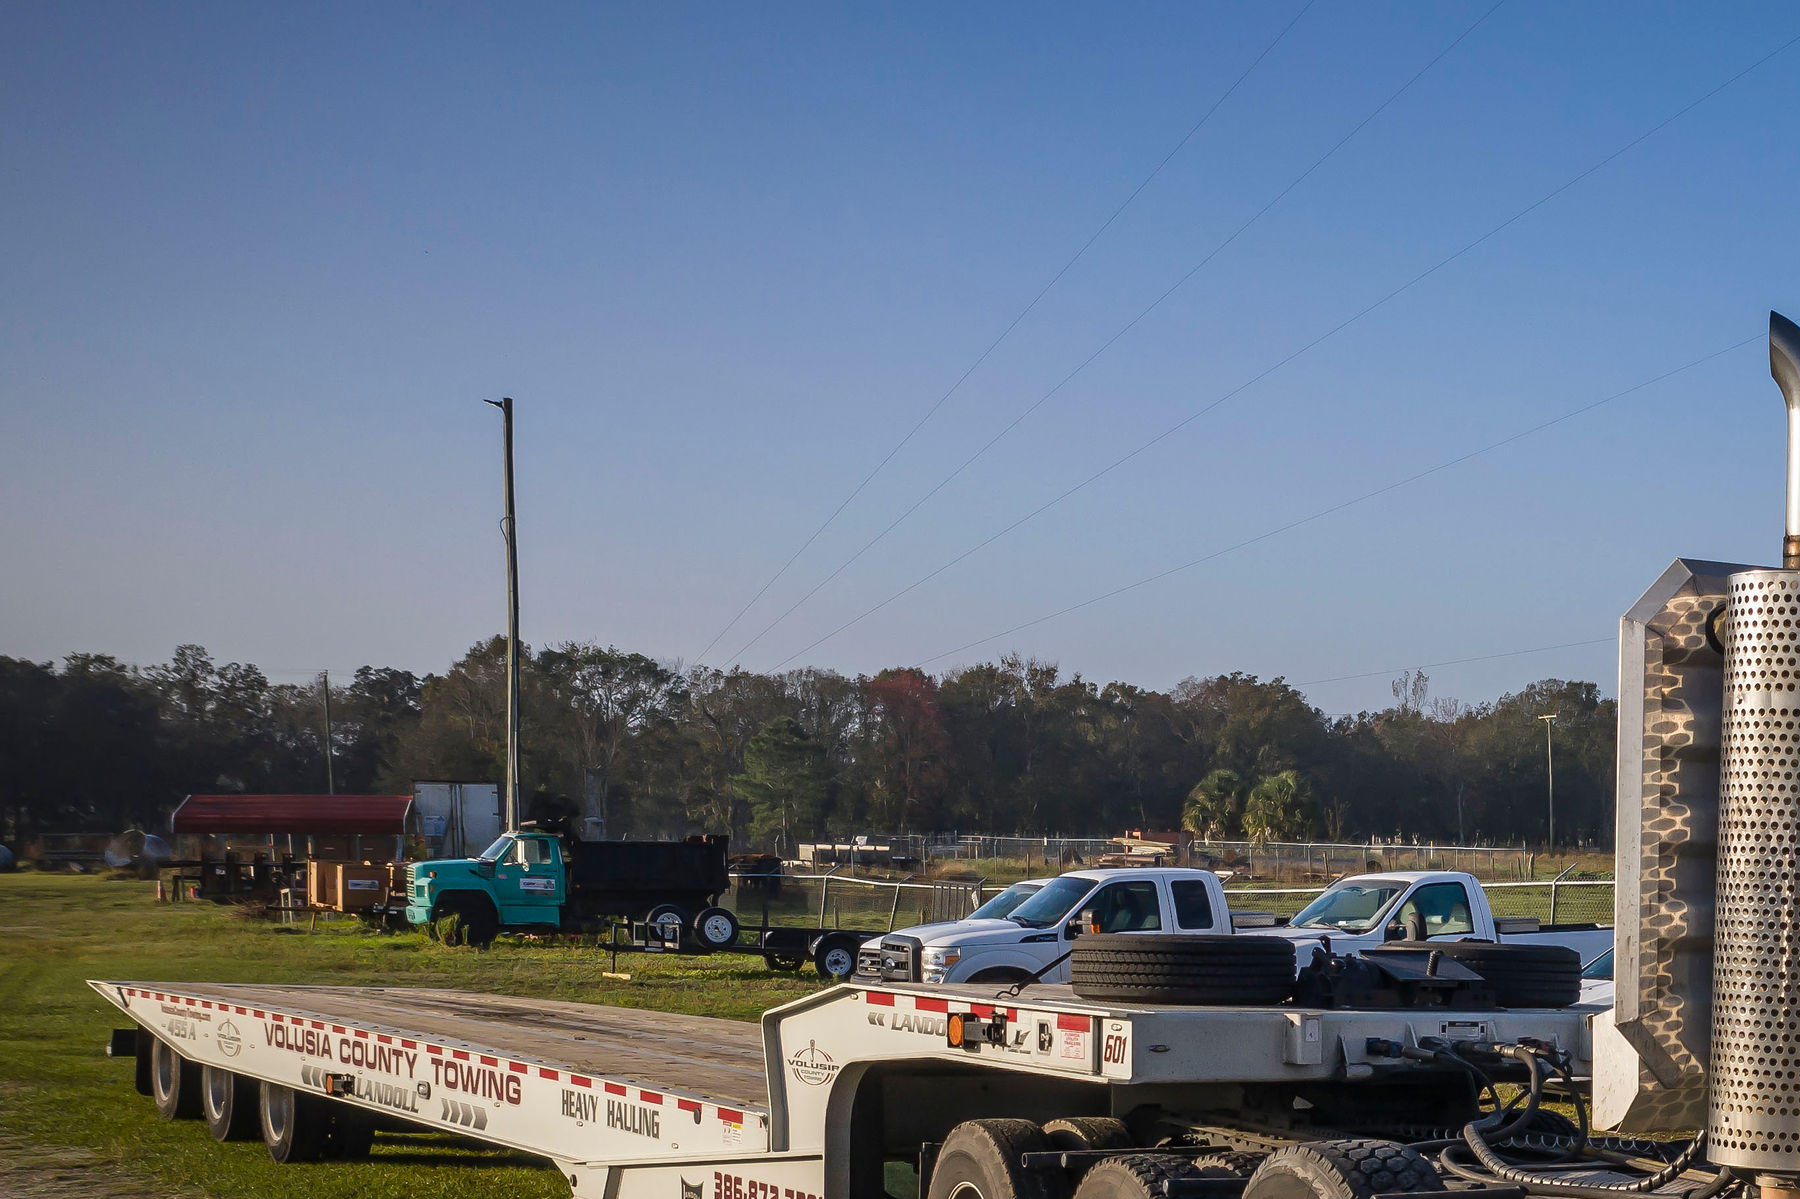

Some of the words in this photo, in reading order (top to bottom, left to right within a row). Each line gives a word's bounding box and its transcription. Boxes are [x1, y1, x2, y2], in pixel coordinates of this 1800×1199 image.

[264, 1023, 333, 1060] VOLUSIA
[339, 1039, 418, 1079] COUNTY
[430, 1057, 522, 1105] TOWING
[1103, 1034, 1128, 1064] 601
[356, 1078, 419, 1113] LANDOLL
[561, 1088, 599, 1123] HEAVY
[606, 1099, 660, 1139] HAULING
